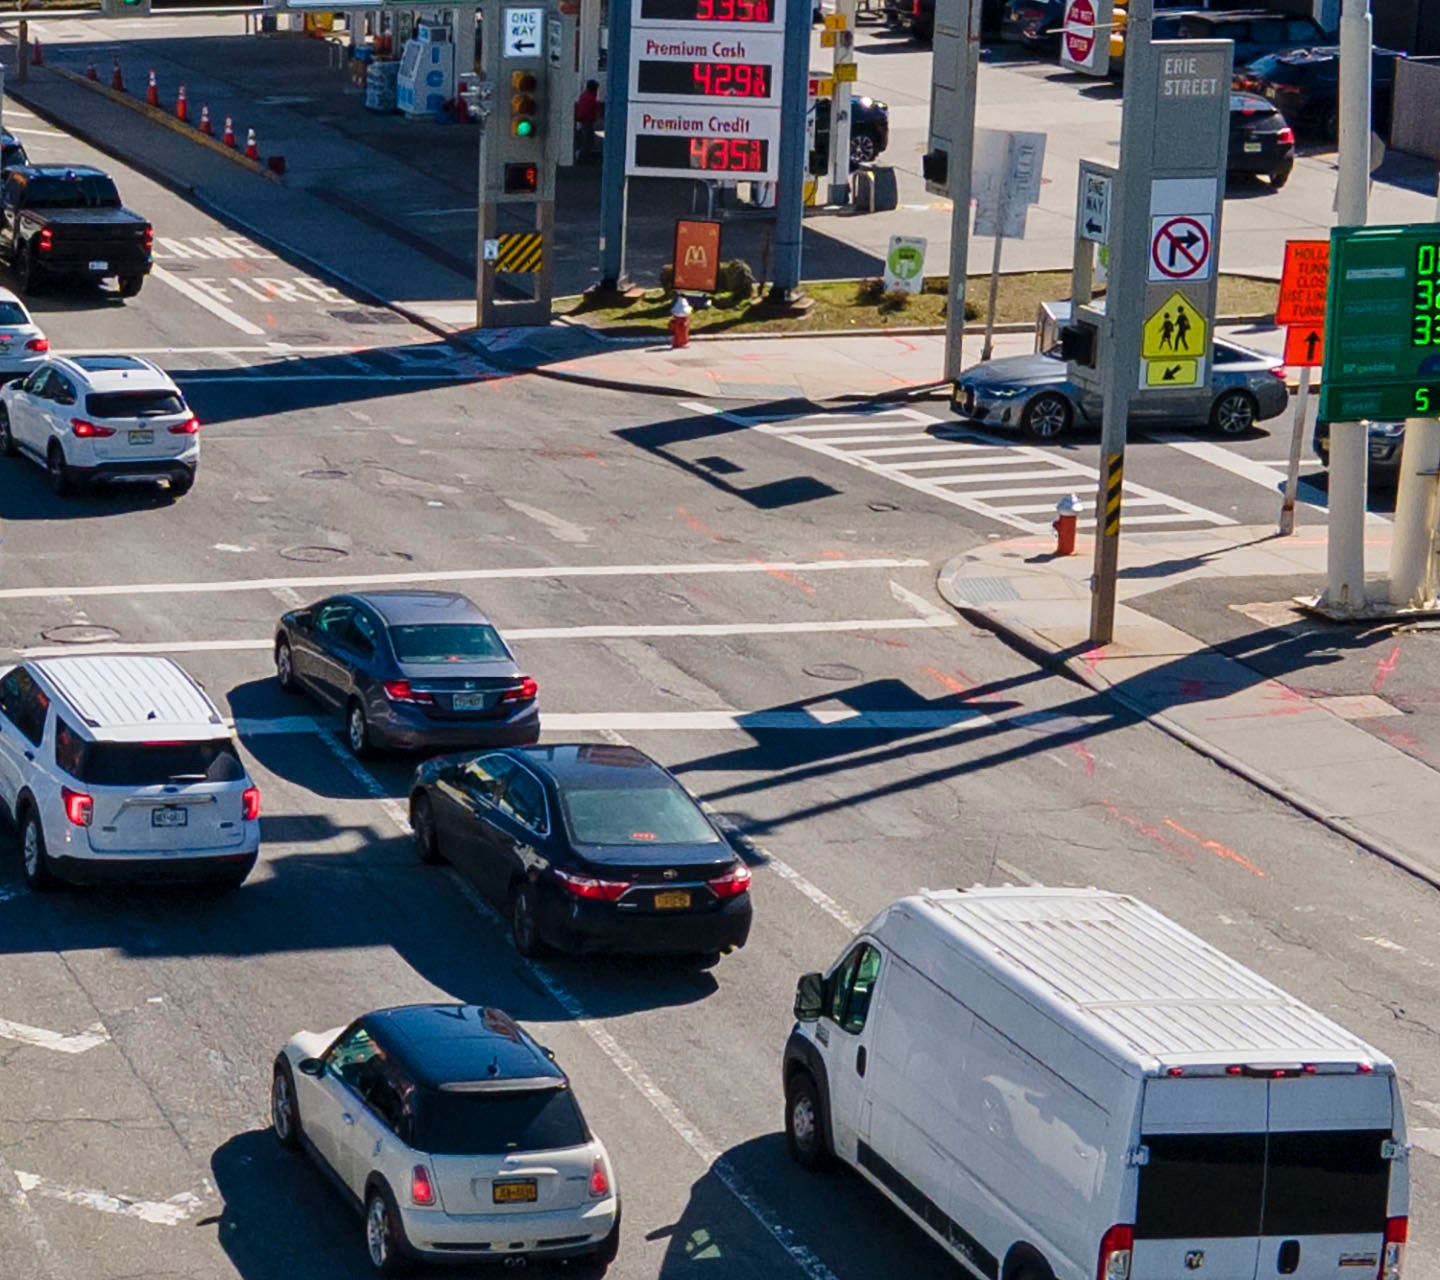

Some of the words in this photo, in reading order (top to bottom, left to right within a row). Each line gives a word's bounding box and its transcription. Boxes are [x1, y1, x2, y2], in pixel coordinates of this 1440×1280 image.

[512, 13, 536, 24] ONE
[512, 25, 537, 36] WAY
[646, 39, 707, 57] Premium
[712, 41, 746, 58] Cash
[1069, 37, 1088, 52] ENTER
[1165, 58, 1197, 75] ERIE
[1163, 77, 1218, 96] STREET
[642, 114, 704, 132] Premium
[708, 116, 750, 133] Credit
[1298, 263, 1327, 275] TUNN
[1292, 306, 1325, 317] TUNN
